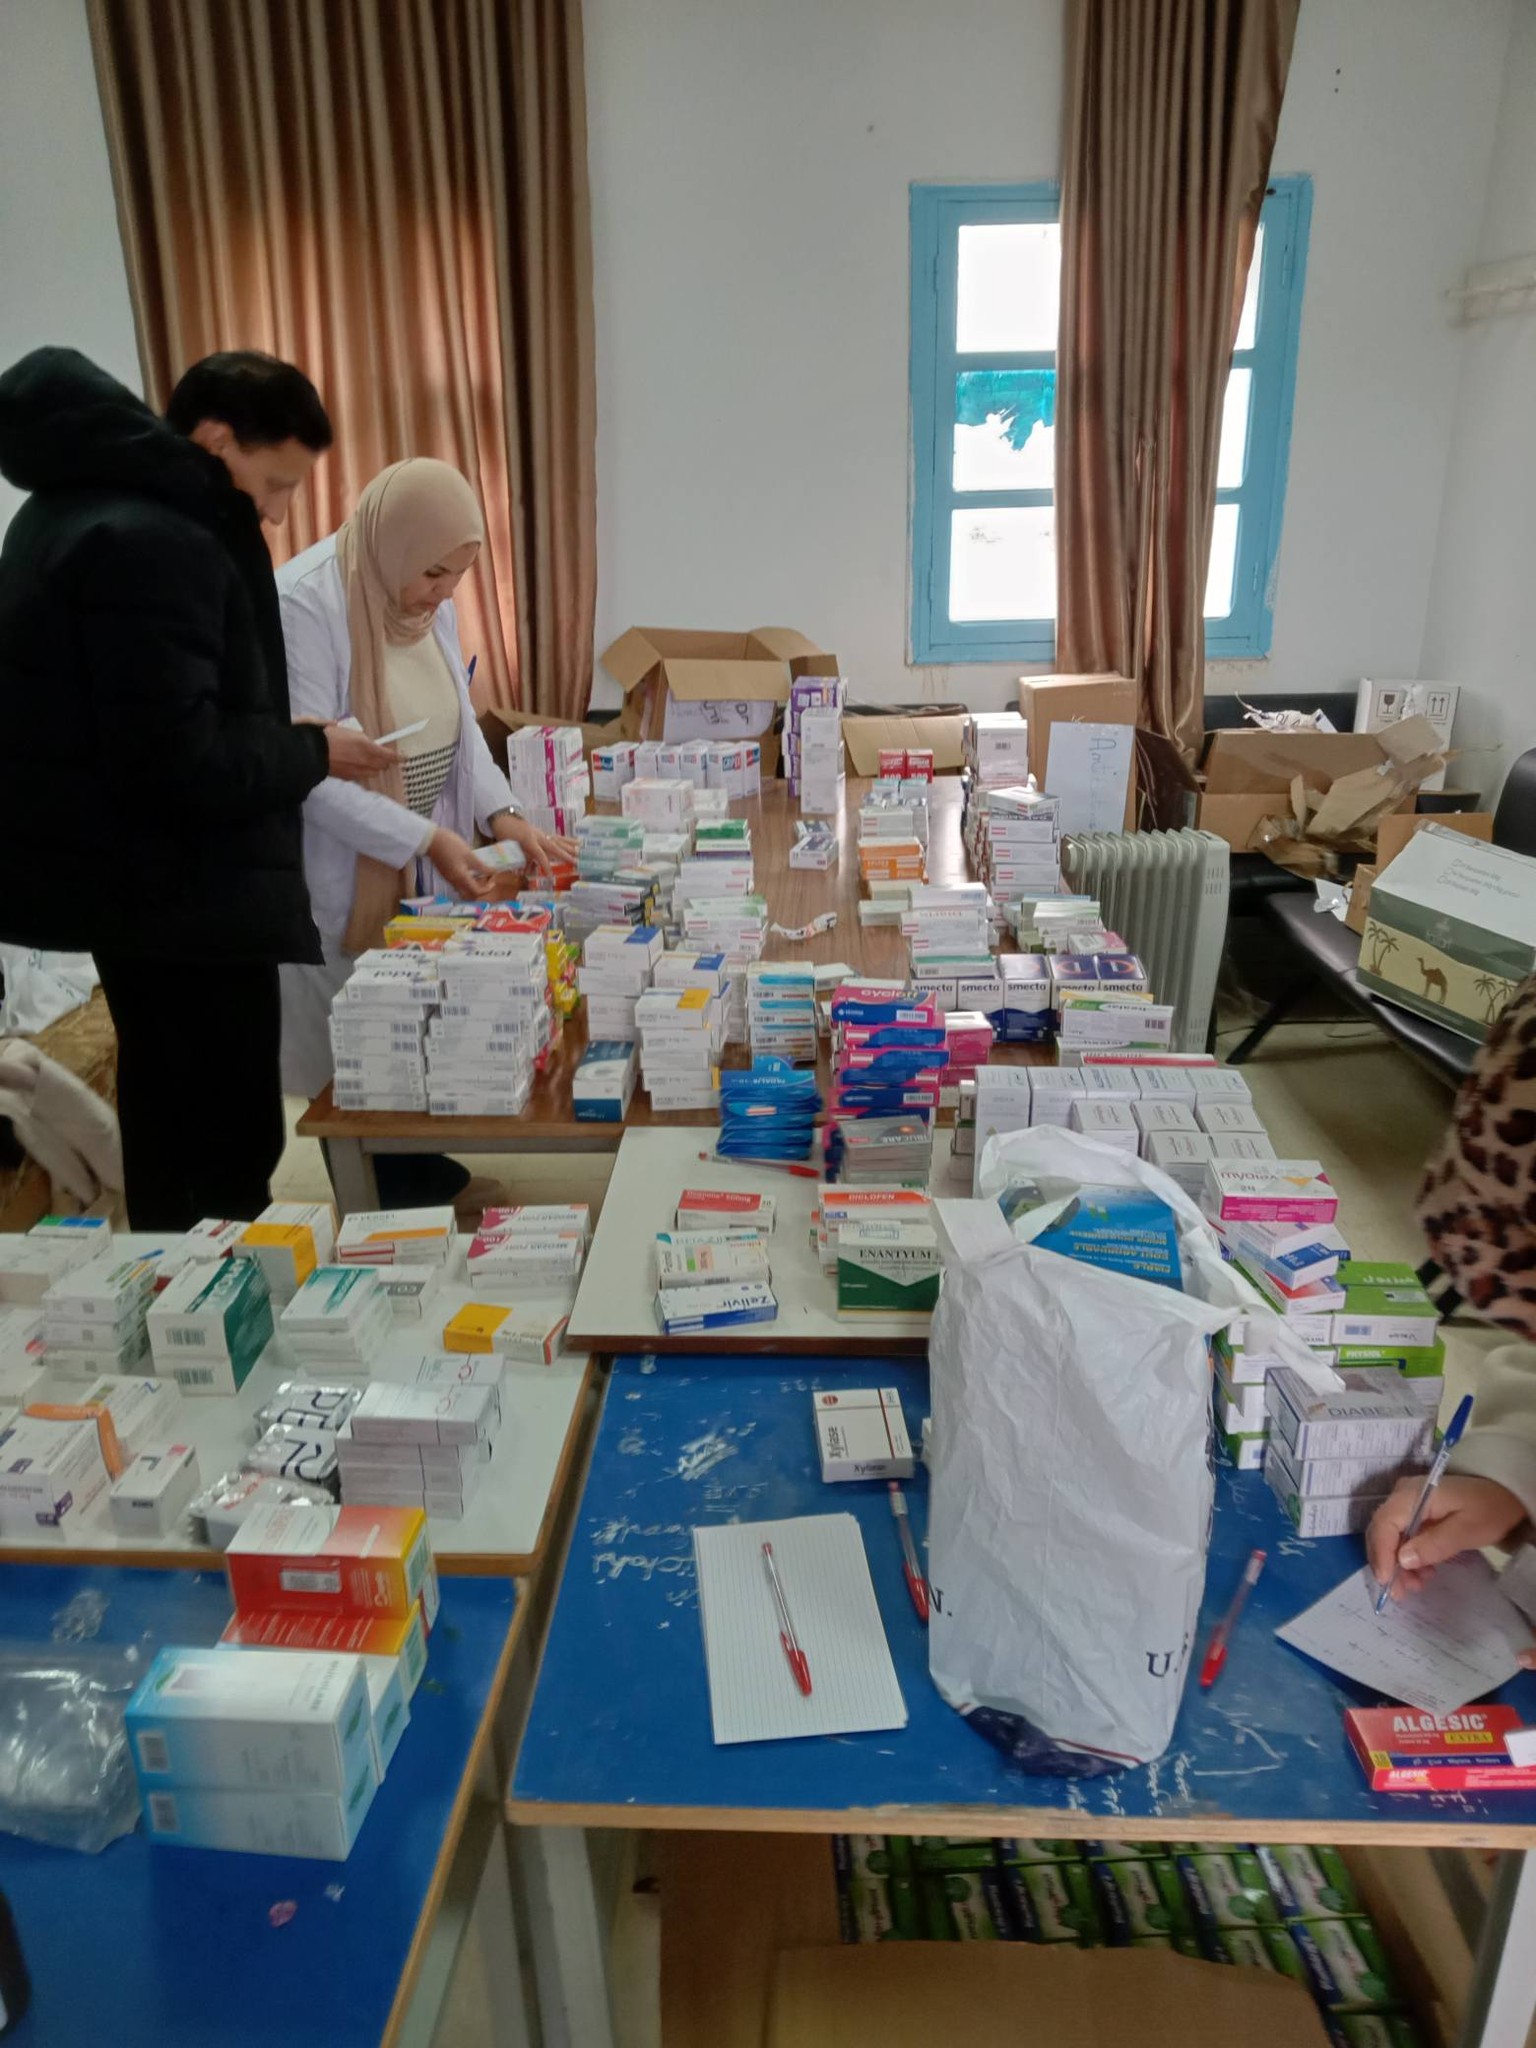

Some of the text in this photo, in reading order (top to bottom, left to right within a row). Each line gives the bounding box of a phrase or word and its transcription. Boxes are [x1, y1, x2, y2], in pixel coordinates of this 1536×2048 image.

[961, 983, 1000, 992] smecta
[1007, 982, 1047, 992] smecta
[1103, 983, 1143, 992] smecta
[859, 1249, 932, 1259] ENANTYUM
[1393, 1714, 1486, 1733] ALGESIC
